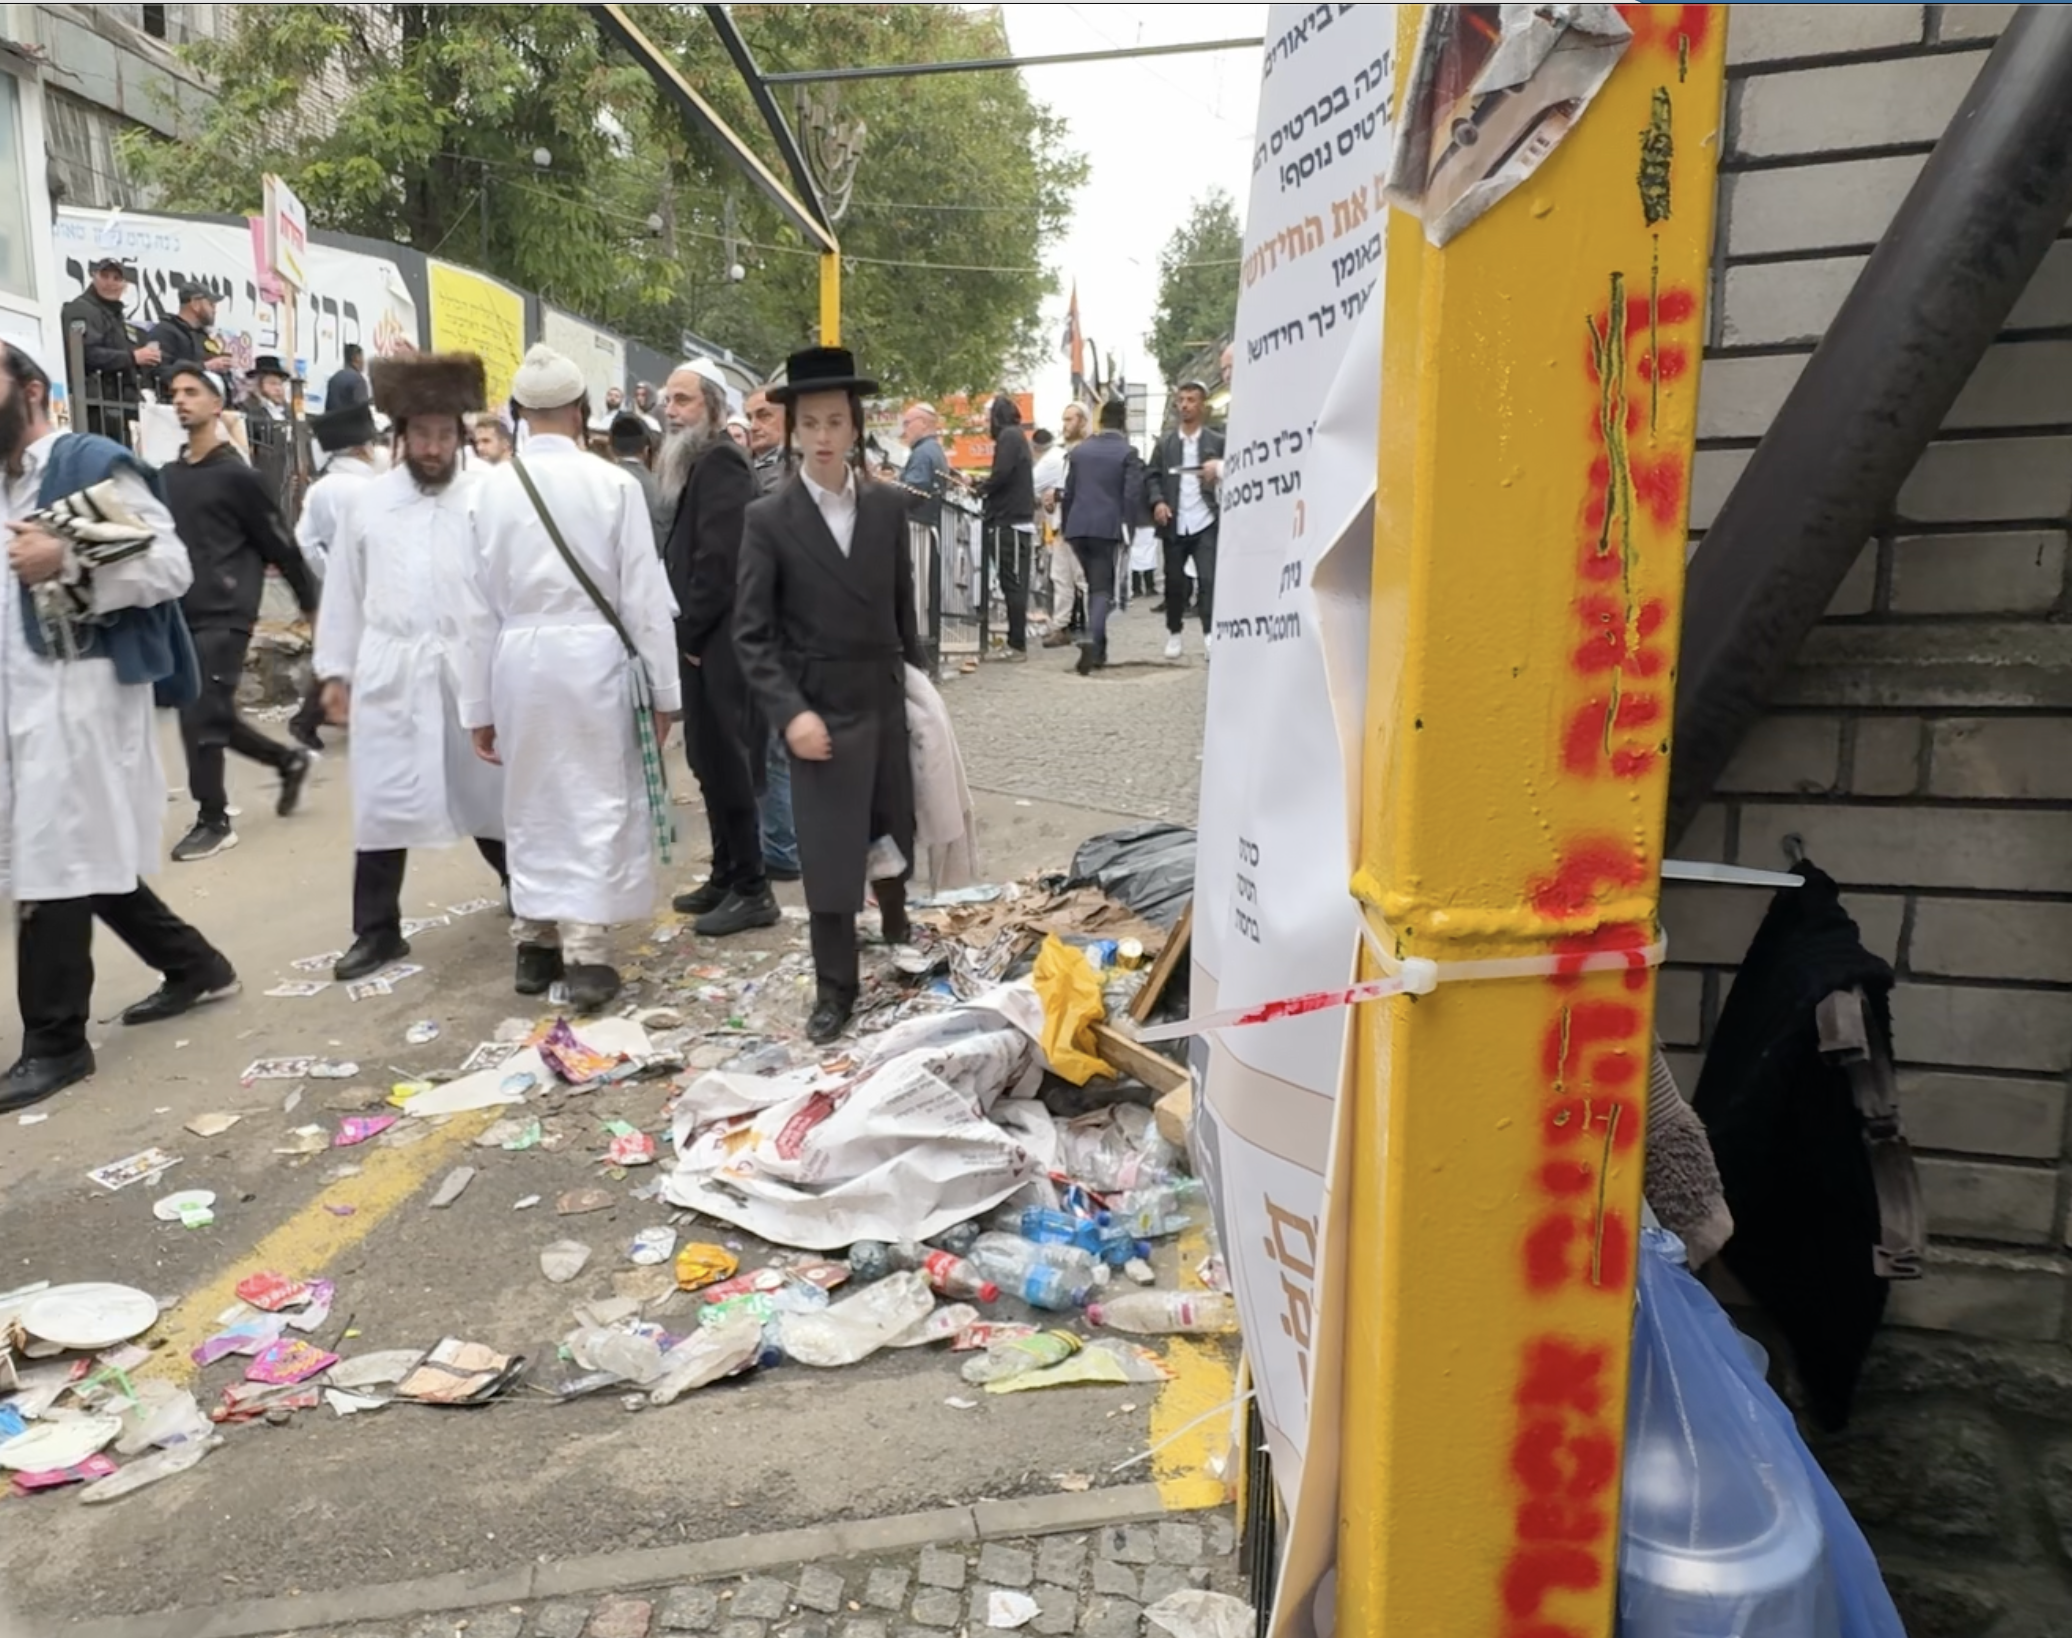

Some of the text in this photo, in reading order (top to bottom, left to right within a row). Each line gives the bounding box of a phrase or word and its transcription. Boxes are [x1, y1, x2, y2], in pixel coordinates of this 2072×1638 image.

[1353, 46, 1395, 101] זכה
[1270, 85, 1350, 156] בכרטיס
[1279, 140, 1333, 193] נוסף!
[1331, 184, 1368, 240] את
[1331, 232, 1382, 288] באומן
[1307, 303, 1336, 339] לך
[1497, 1333, 1618, 1637] אסור
